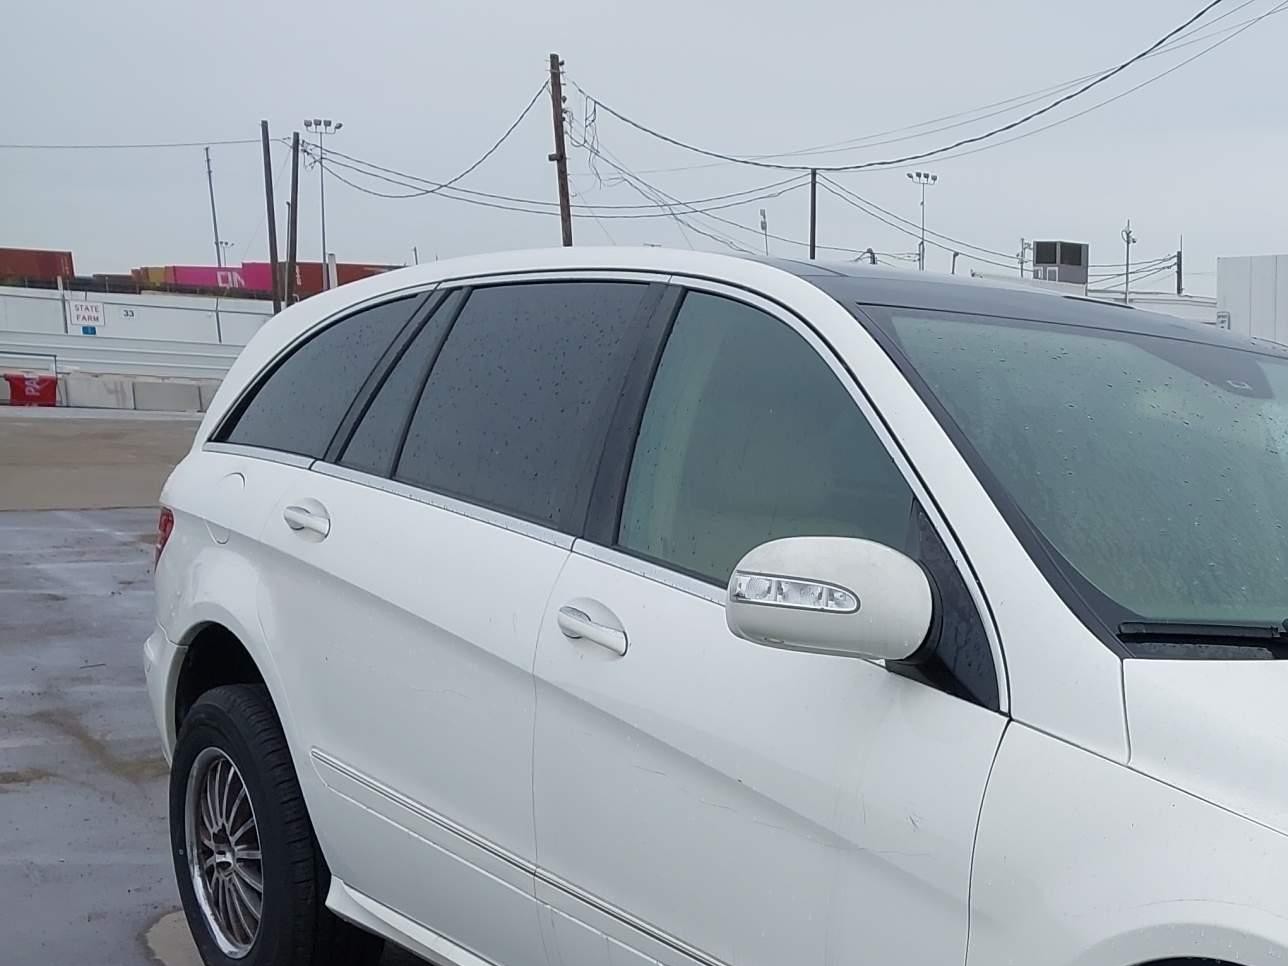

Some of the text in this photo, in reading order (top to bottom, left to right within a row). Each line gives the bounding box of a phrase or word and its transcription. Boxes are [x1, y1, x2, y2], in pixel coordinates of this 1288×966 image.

[74, 304, 99, 312] STATE
[123, 309, 135, 317] 33
[76, 314, 99, 322] FARM
